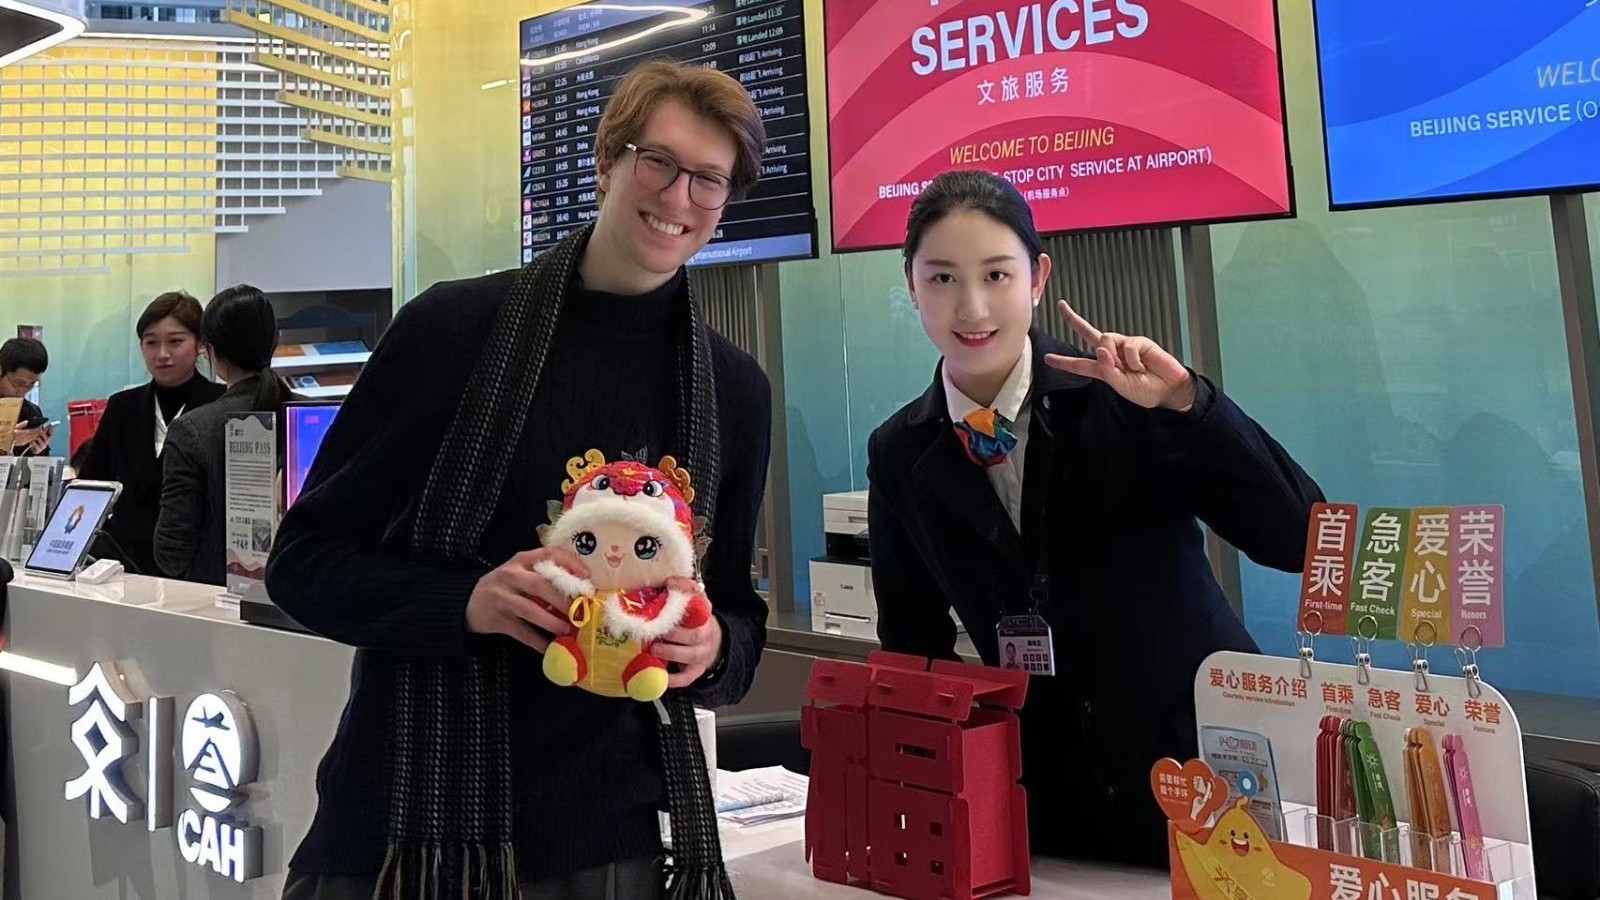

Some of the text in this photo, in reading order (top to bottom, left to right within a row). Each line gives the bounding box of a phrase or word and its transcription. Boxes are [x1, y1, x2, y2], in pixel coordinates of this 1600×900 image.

[911, 0, 1149, 76] SERVICES
[977, 67, 1069, 105] 文旅服务
[1410, 99, 1600, 138] BEIJING SERVICE (O
[950, 126, 1115, 165] WELCOME TO BEIJING
[1003, 145, 1213, 184] STOP CITY SERVICE AT AIRPORT)
[879, 183, 920, 199] BEIJING
[1308, 508, 1351, 597] 首乘
[1359, 512, 1402, 602] 急客
[1410, 513, 1450, 604] 爱心
[1458, 510, 1495, 606] 荣誉
[1304, 599, 1343, 611] First-time
[1350, 602, 1396, 616] Fast Check
[1410, 608, 1442, 620] Special
[1461, 608, 1487, 620] Honors
[1210, 667, 1307, 699] 爱心服务介绍
[1320, 681, 1354, 705] 首乘
[1367, 687, 1401, 712] 急客
[1415, 693, 1451, 717] 爱心
[1464, 699, 1501, 725] 荣誉
[177, 808, 245, 884] CAH
